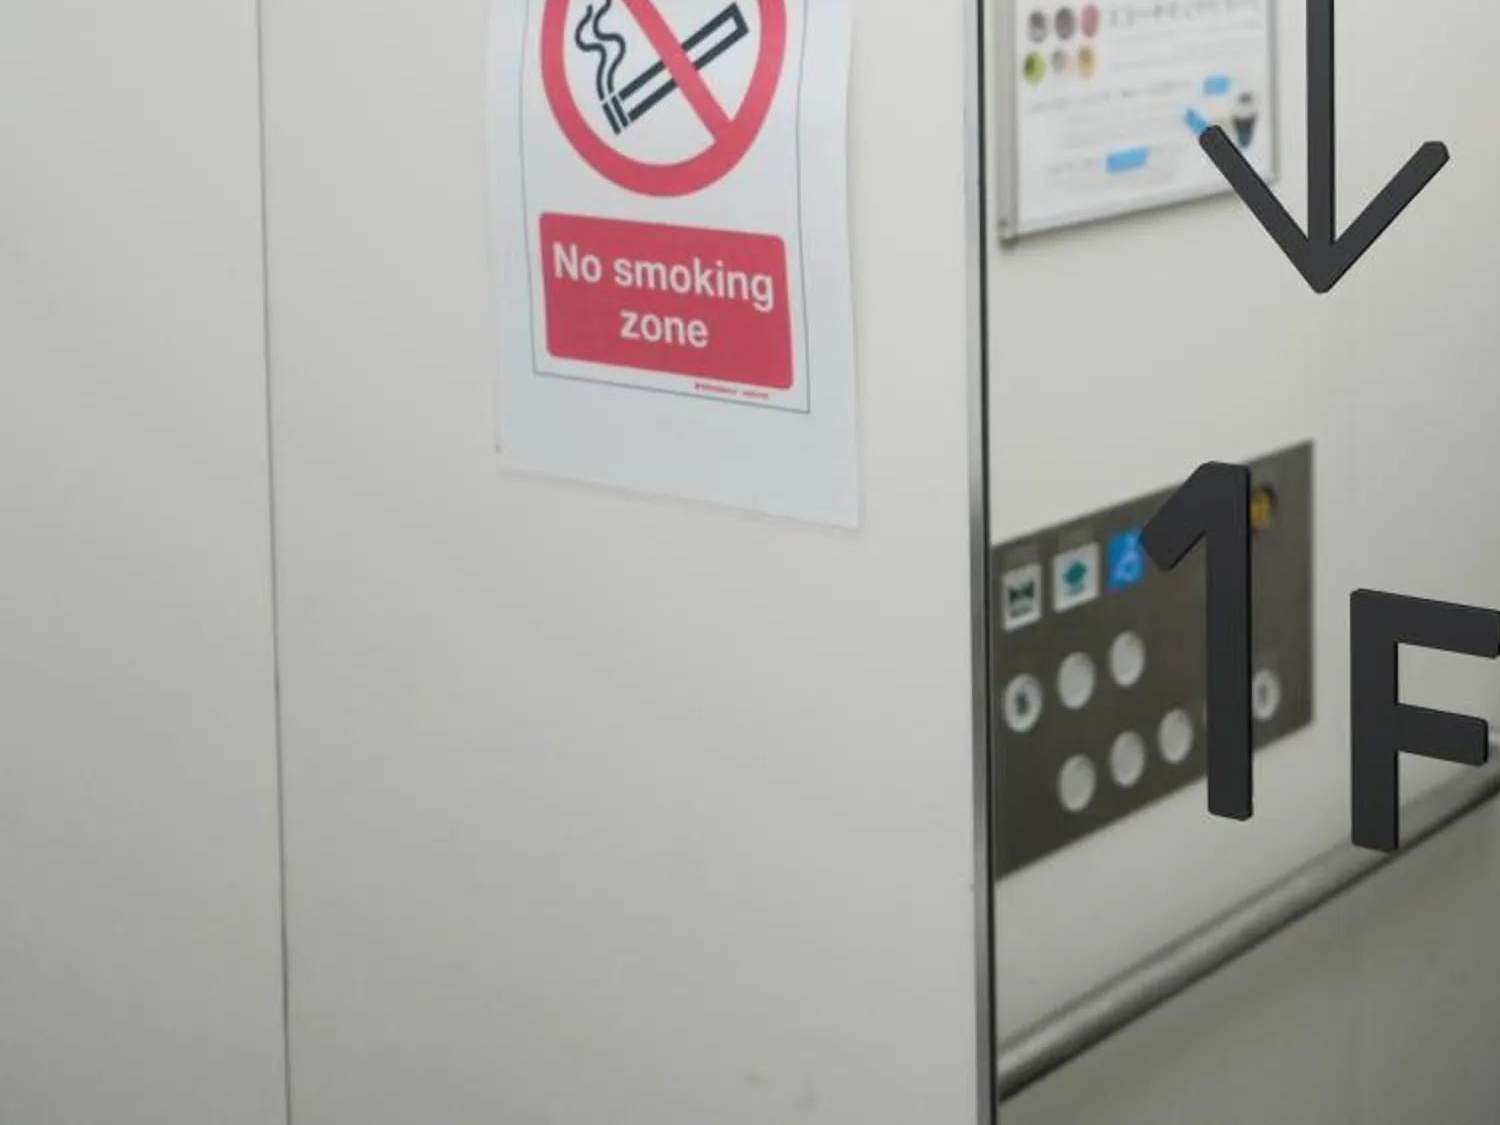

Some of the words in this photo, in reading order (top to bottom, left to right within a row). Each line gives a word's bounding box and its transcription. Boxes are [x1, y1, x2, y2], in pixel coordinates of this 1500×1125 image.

[553, 242, 602, 283] No
[613, 257, 774, 313] smoking
[620, 310, 708, 348] zone
